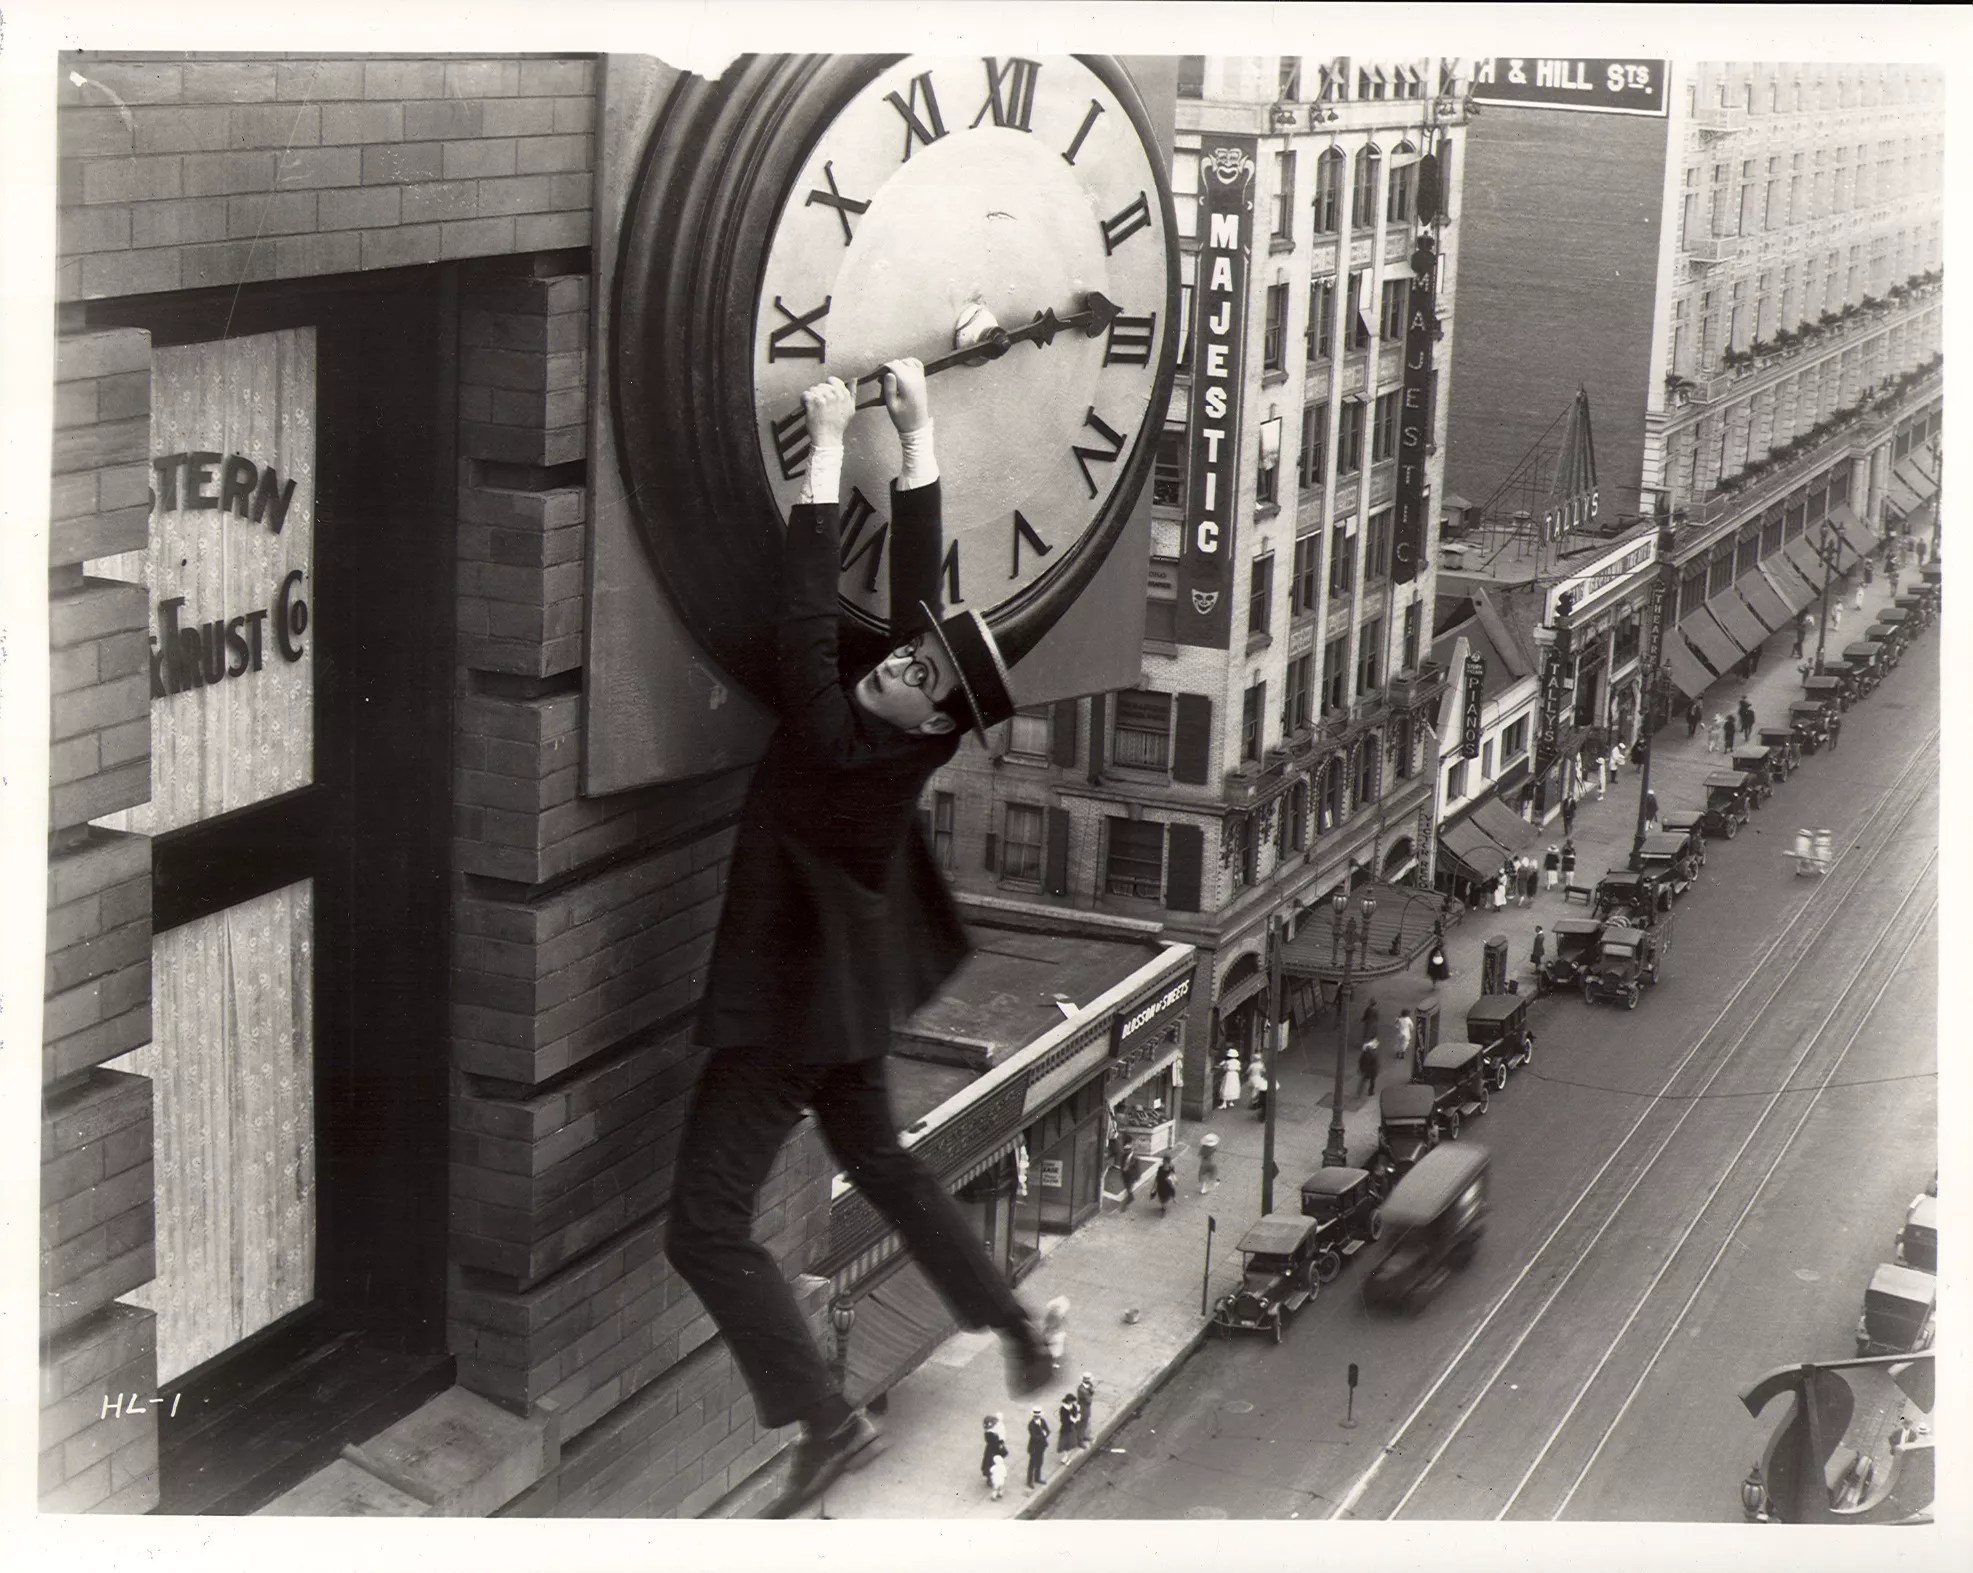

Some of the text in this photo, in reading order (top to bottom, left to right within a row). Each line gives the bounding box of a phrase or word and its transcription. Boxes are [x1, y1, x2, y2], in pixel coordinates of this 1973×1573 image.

[969, 56, 1042, 132] XII
[1508, 59, 1527, 84] &
[1536, 59, 1594, 90] HILL
[883, 70, 950, 162] XI
[1062, 98, 1105, 165] I
[805, 160, 872, 246] X
[1100, 190, 1151, 256] II
[770, 295, 832, 364] IX
[1103, 311, 1156, 369] III
[1197, 212, 1240, 554] MAJESTIC
[1396, 272, 1430, 562] MAJESTIC
[1071, 406, 1127, 500] IV
[149, 451, 297, 534] TERN
[1009, 510, 1053, 579] V
[158, 596, 268, 695] TRUST
[1650, 593, 1664, 665] THEATRE
[1466, 677, 1480, 754] PIANOS
